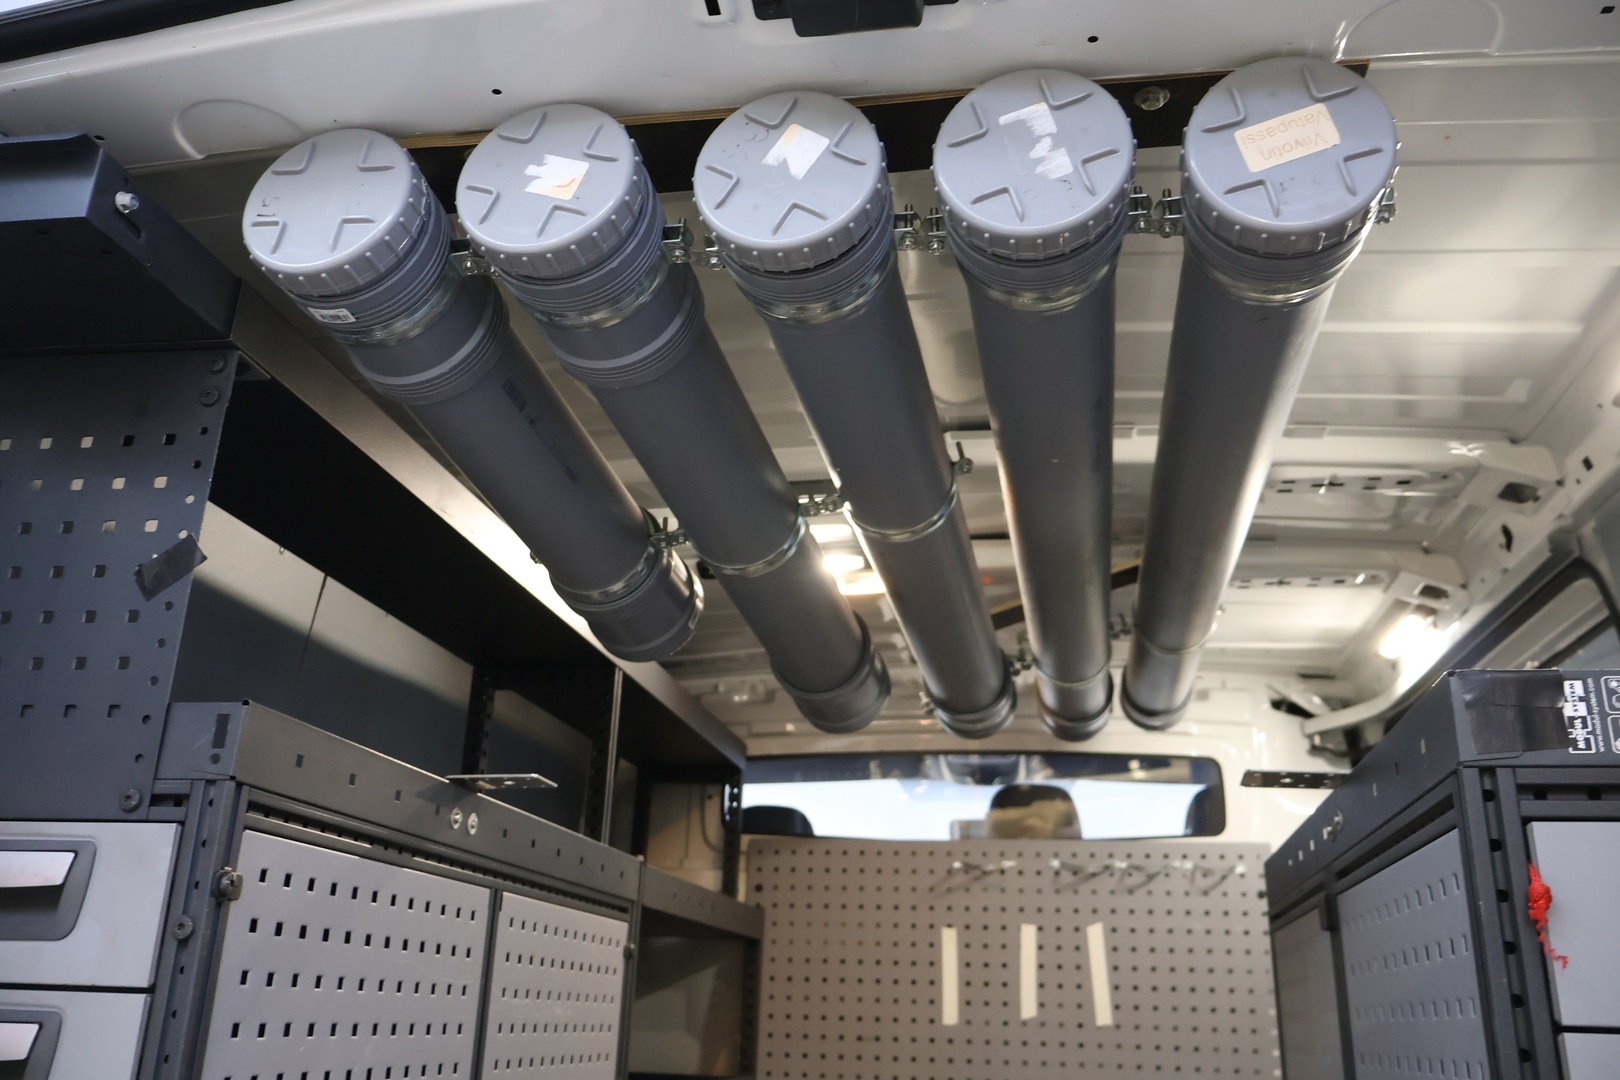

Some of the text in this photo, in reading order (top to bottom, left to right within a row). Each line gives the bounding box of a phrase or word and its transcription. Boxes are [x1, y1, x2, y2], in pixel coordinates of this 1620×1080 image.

[1241, 110, 1331, 149] Vatupassi
[1260, 132, 1328, 160] Viivotin
[1587, 677, 1605, 753] www.modul-system.com
